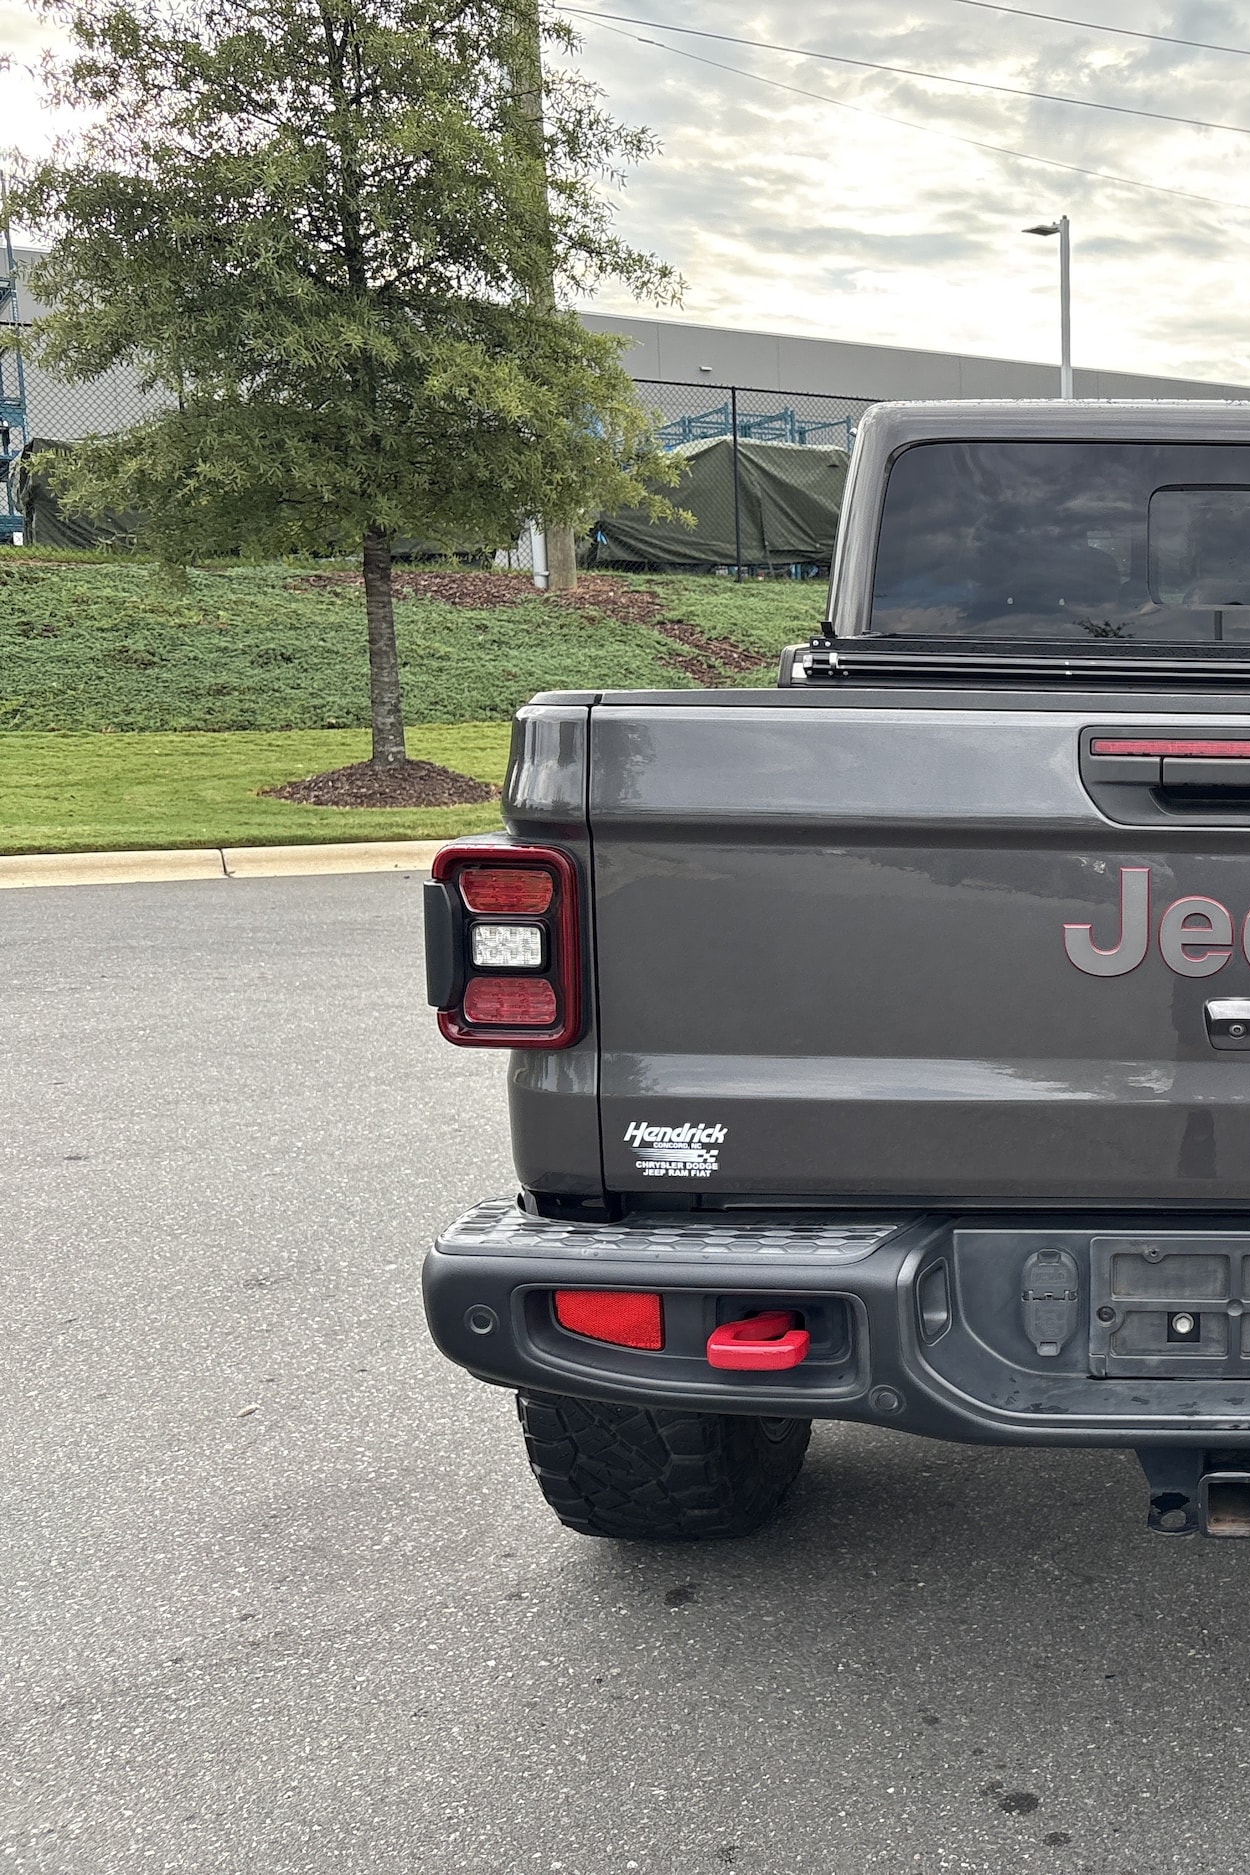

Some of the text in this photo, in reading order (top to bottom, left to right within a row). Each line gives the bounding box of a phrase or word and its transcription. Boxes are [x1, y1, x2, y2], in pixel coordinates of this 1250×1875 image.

[623, 1121, 728, 1147] Hendrick
[635, 1161, 719, 1170] CHRYSLER DODGE
[668, 1169, 689, 1177] RAM
